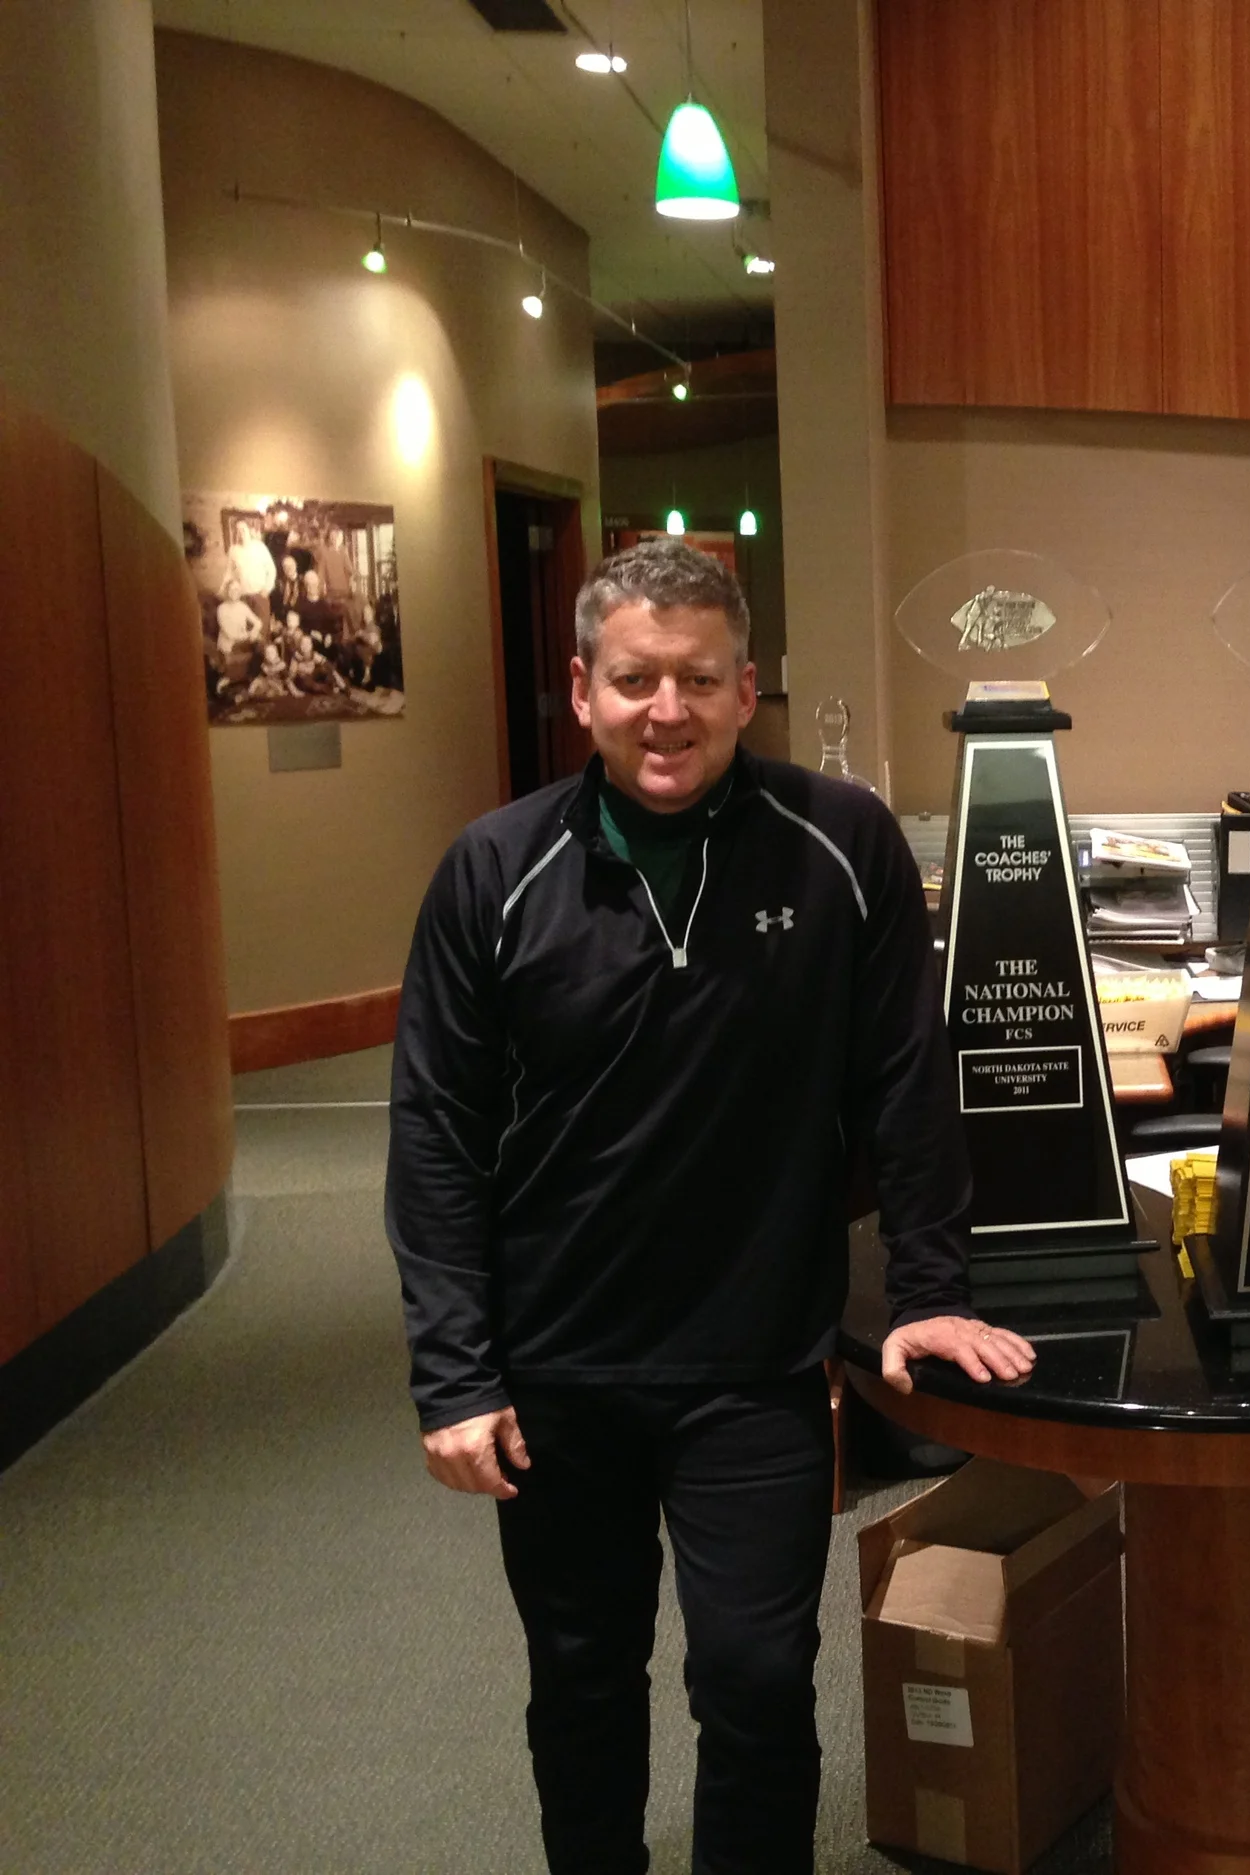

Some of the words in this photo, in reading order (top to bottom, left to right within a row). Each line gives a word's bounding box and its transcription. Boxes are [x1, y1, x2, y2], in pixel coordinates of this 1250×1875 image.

[1000, 835, 1025, 849] THE
[975, 850, 1051, 867] COACHES'
[985, 867, 1042, 883] TROPHY
[995, 959, 1038, 977] THE
[964, 981, 1071, 1001] NATIONAL
[961, 1004, 1074, 1025] CHAMPION
[1005, 1027, 1033, 1041] FCS
[972, 1065, 1003, 1074] NORTH
[1004, 1063, 1041, 1073] DAKOTA
[1042, 1061, 1070, 1071] STATE
[994, 1074, 1047, 1084] UNIVERSITY
[1013, 1086, 1030, 1095] 2011
